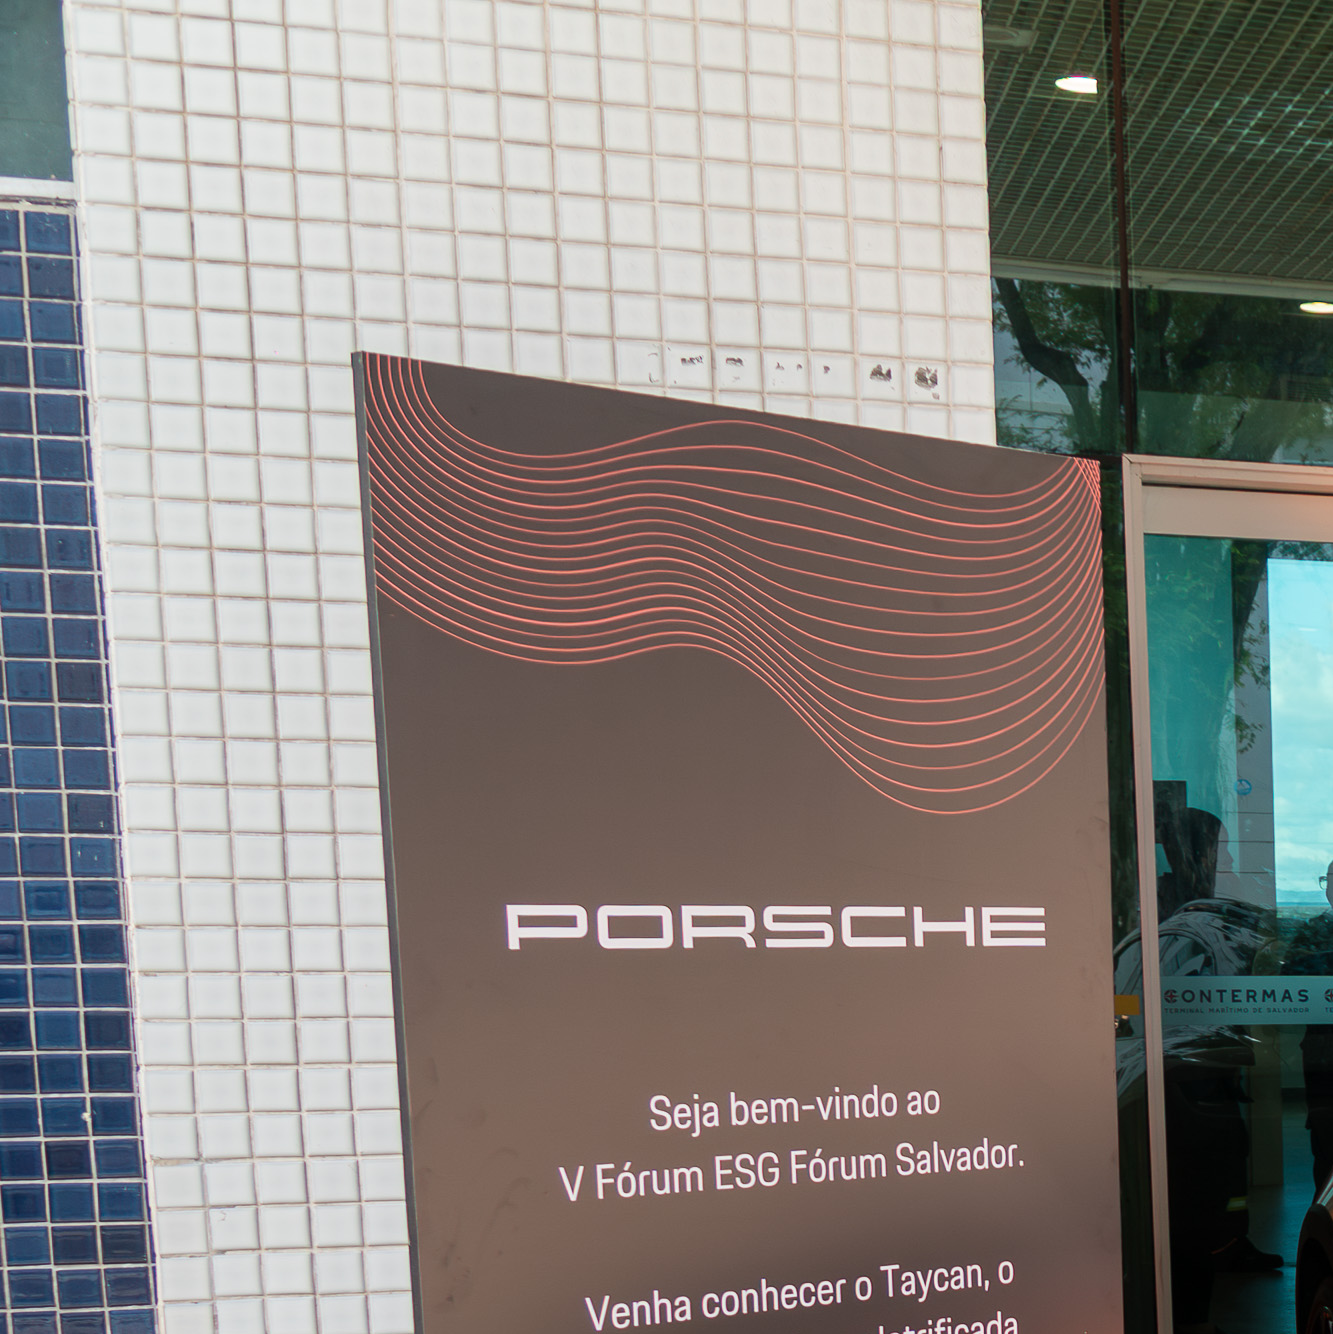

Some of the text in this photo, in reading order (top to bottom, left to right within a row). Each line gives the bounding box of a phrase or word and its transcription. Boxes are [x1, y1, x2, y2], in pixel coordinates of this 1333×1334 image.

[505, 903, 1046, 950] PORSCHE
[1164, 989, 1310, 1004] CONTERMAS
[649, 1085, 941, 1138] Seja bem-vindo ao
[559, 1138, 1025, 1202] V Fórum ESG Fórum Salvador.
[585, 1260, 1015, 1331] Venha conhecer o Taycan, o
